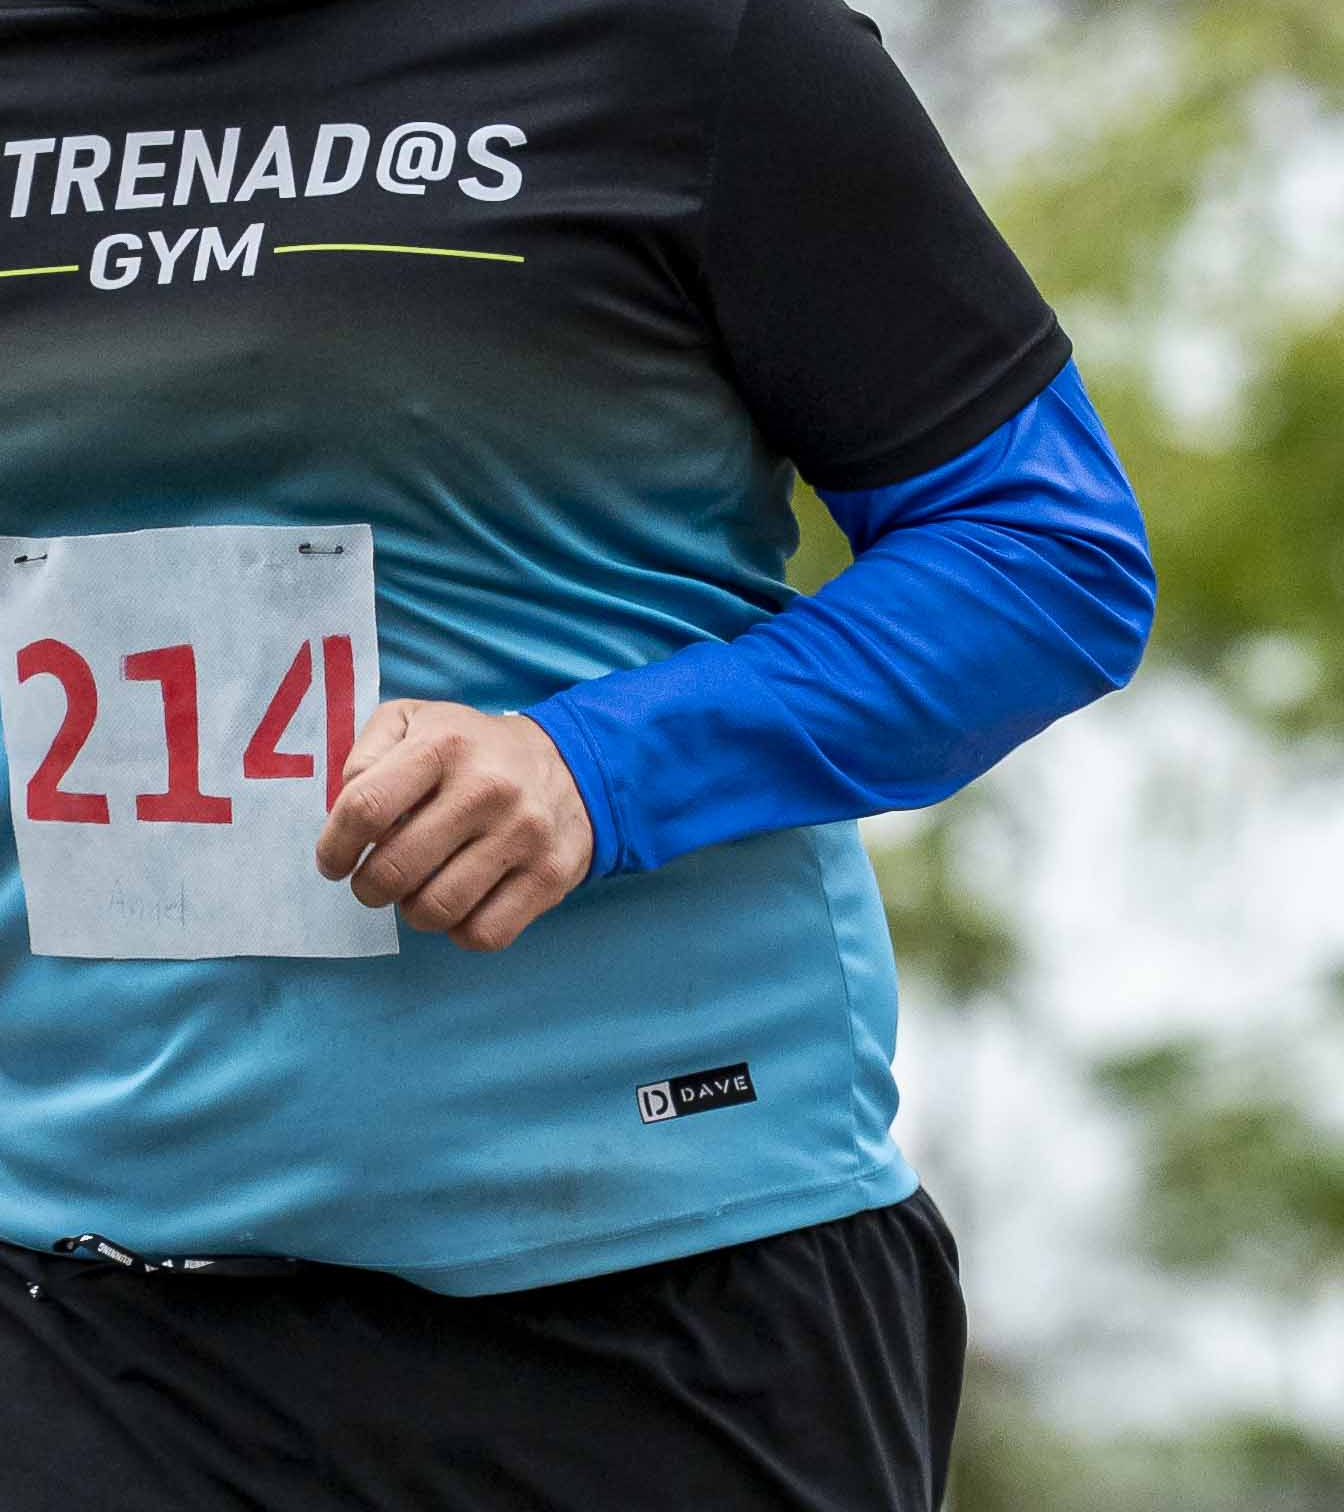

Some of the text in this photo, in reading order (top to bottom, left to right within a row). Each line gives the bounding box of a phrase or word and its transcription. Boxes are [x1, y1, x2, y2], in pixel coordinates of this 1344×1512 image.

[88, 223, 266, 291] GYM
[16, 633, 356, 825] 214
[680, 1074, 749, 1103] DAVE
